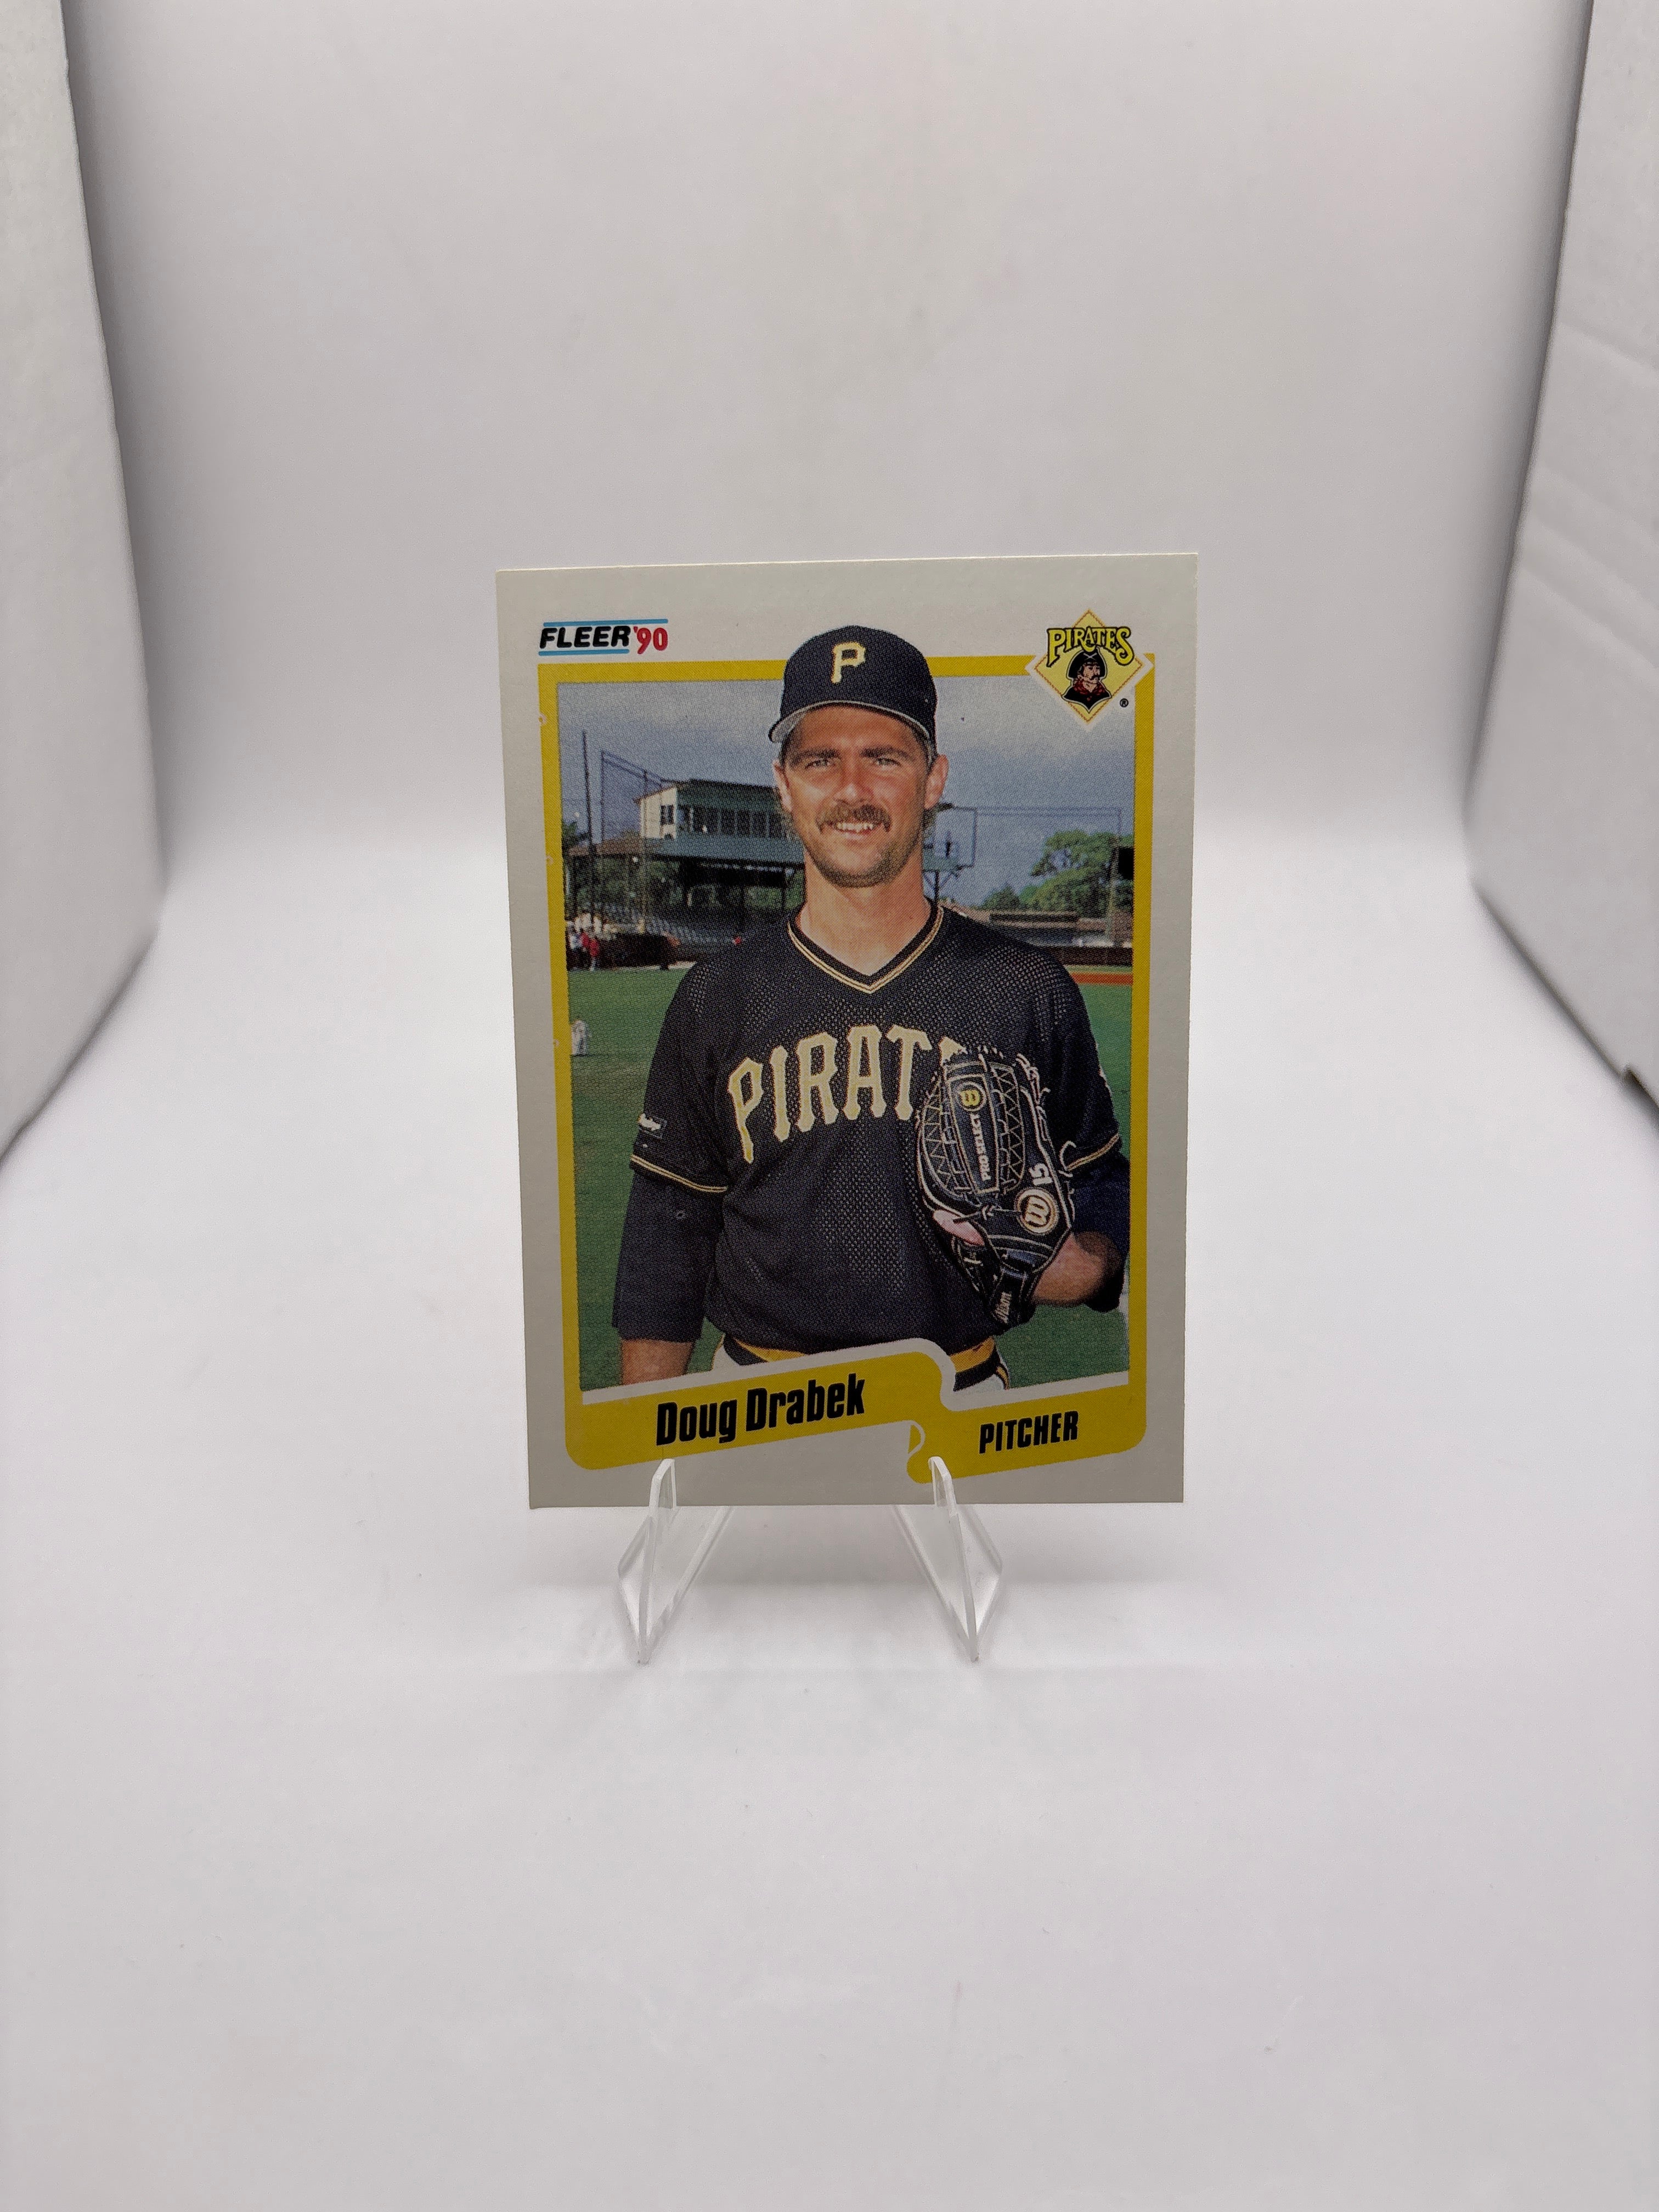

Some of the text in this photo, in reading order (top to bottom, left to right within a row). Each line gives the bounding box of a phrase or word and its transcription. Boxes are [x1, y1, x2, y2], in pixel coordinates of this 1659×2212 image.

[540, 625, 668, 654] FLEER '90
[1046, 626, 1135, 667] PIRATES
[831, 641, 866, 685] P
[727, 1024, 967, 1164] PIRAT
[656, 1373, 865, 1446] Doug Drabek
[979, 1410, 1079, 1454] PITCHER
